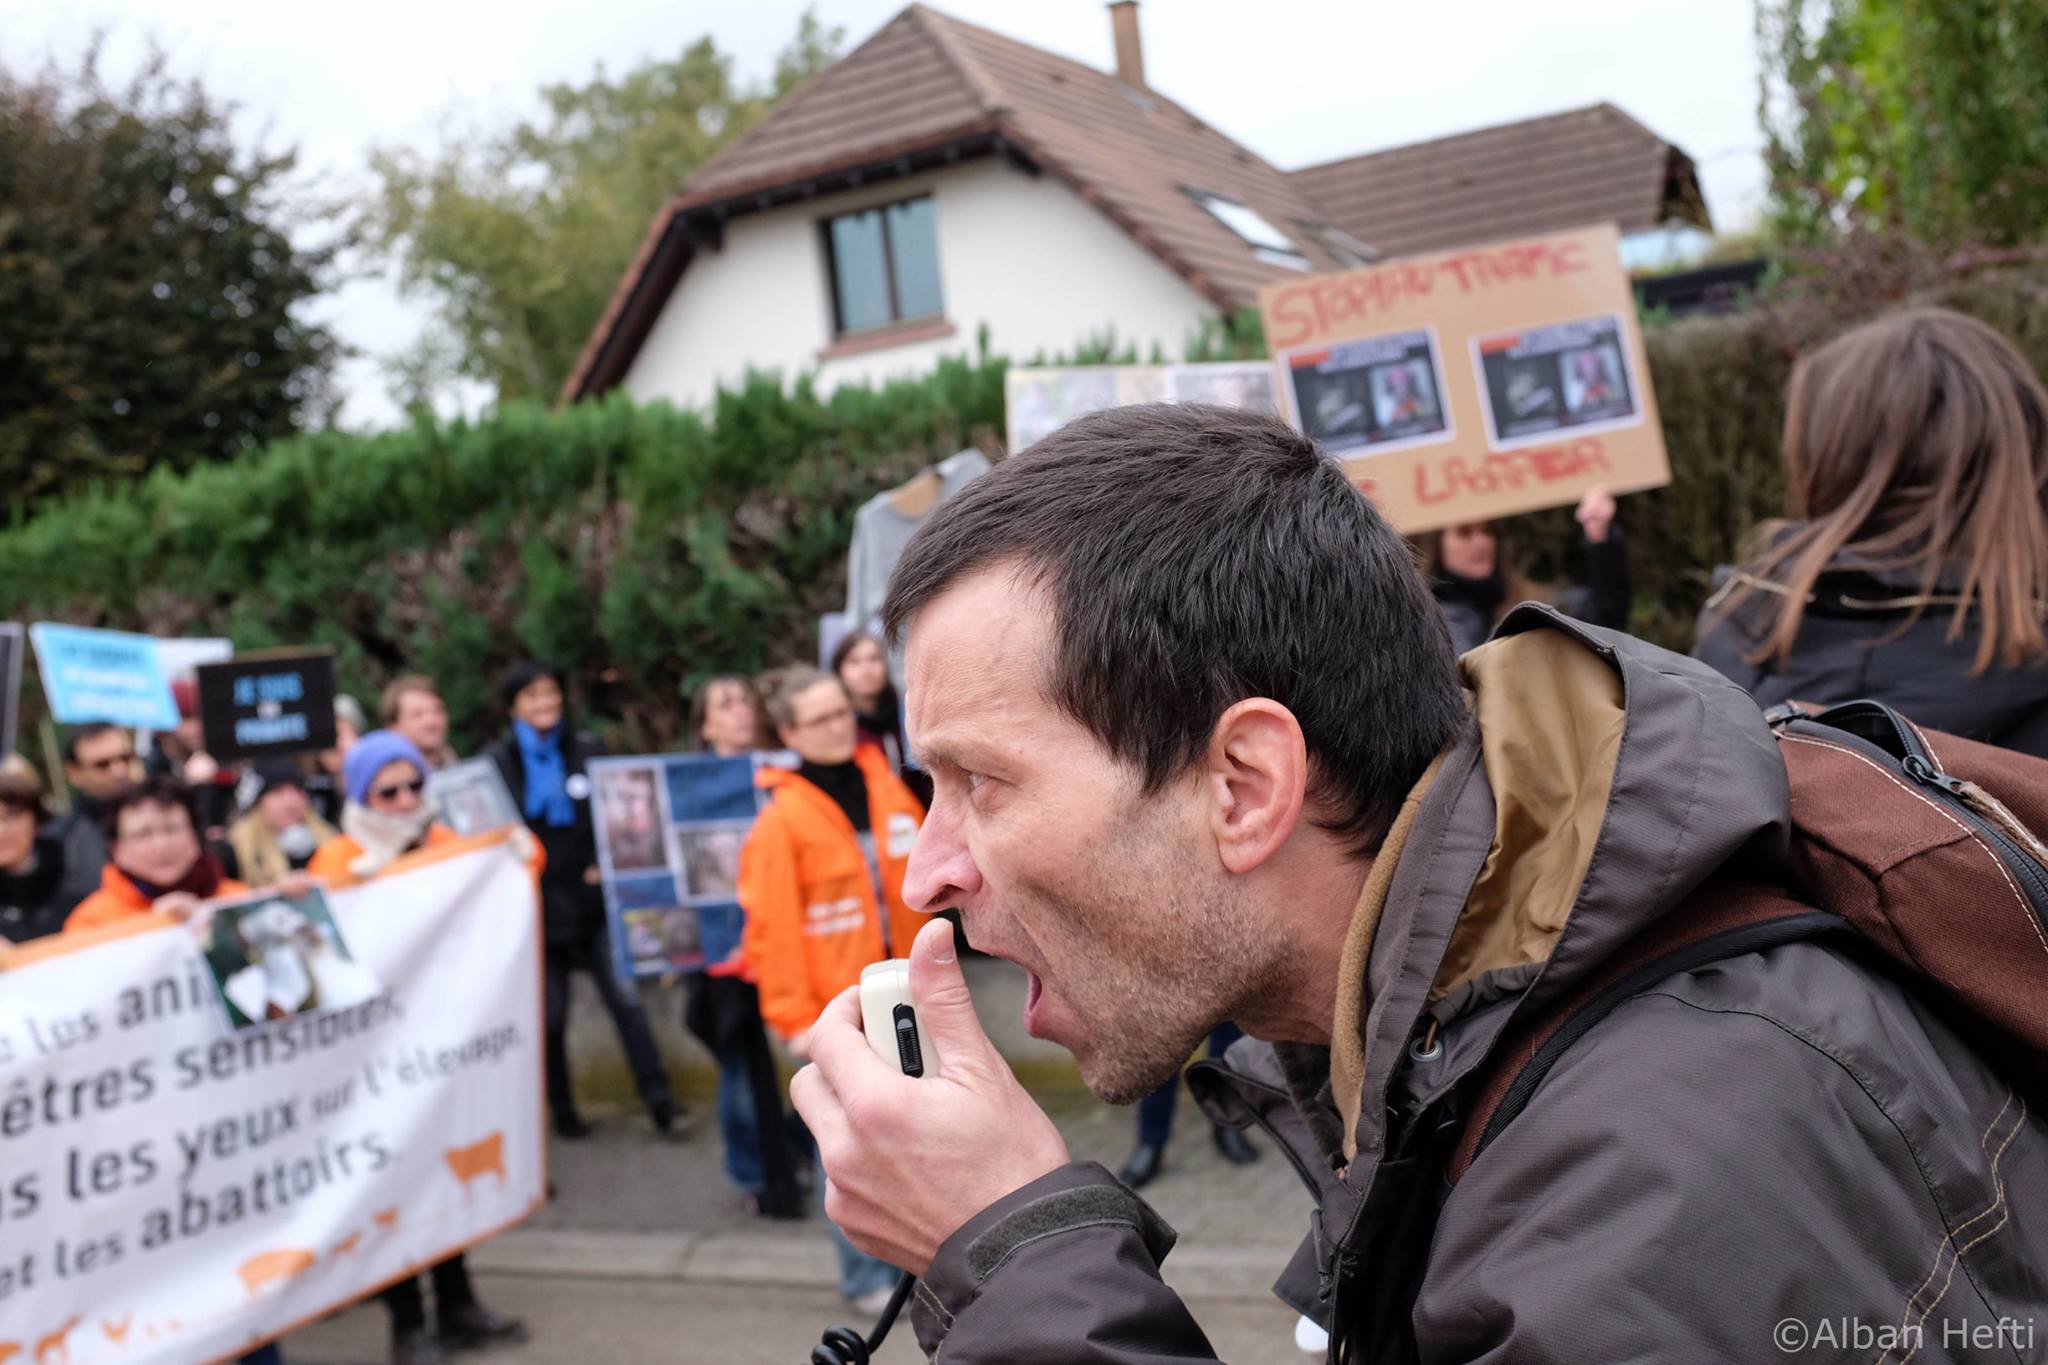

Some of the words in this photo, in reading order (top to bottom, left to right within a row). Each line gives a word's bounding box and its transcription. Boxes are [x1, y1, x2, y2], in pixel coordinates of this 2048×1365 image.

[2, 1056, 156, 1138] êtres
[0, 1172, 40, 1222] s
[66, 1140, 158, 1201] les
[176, 1096, 303, 1183] yeux
[309, 1075, 355, 1123] sur
[55, 1231, 125, 1278] les
